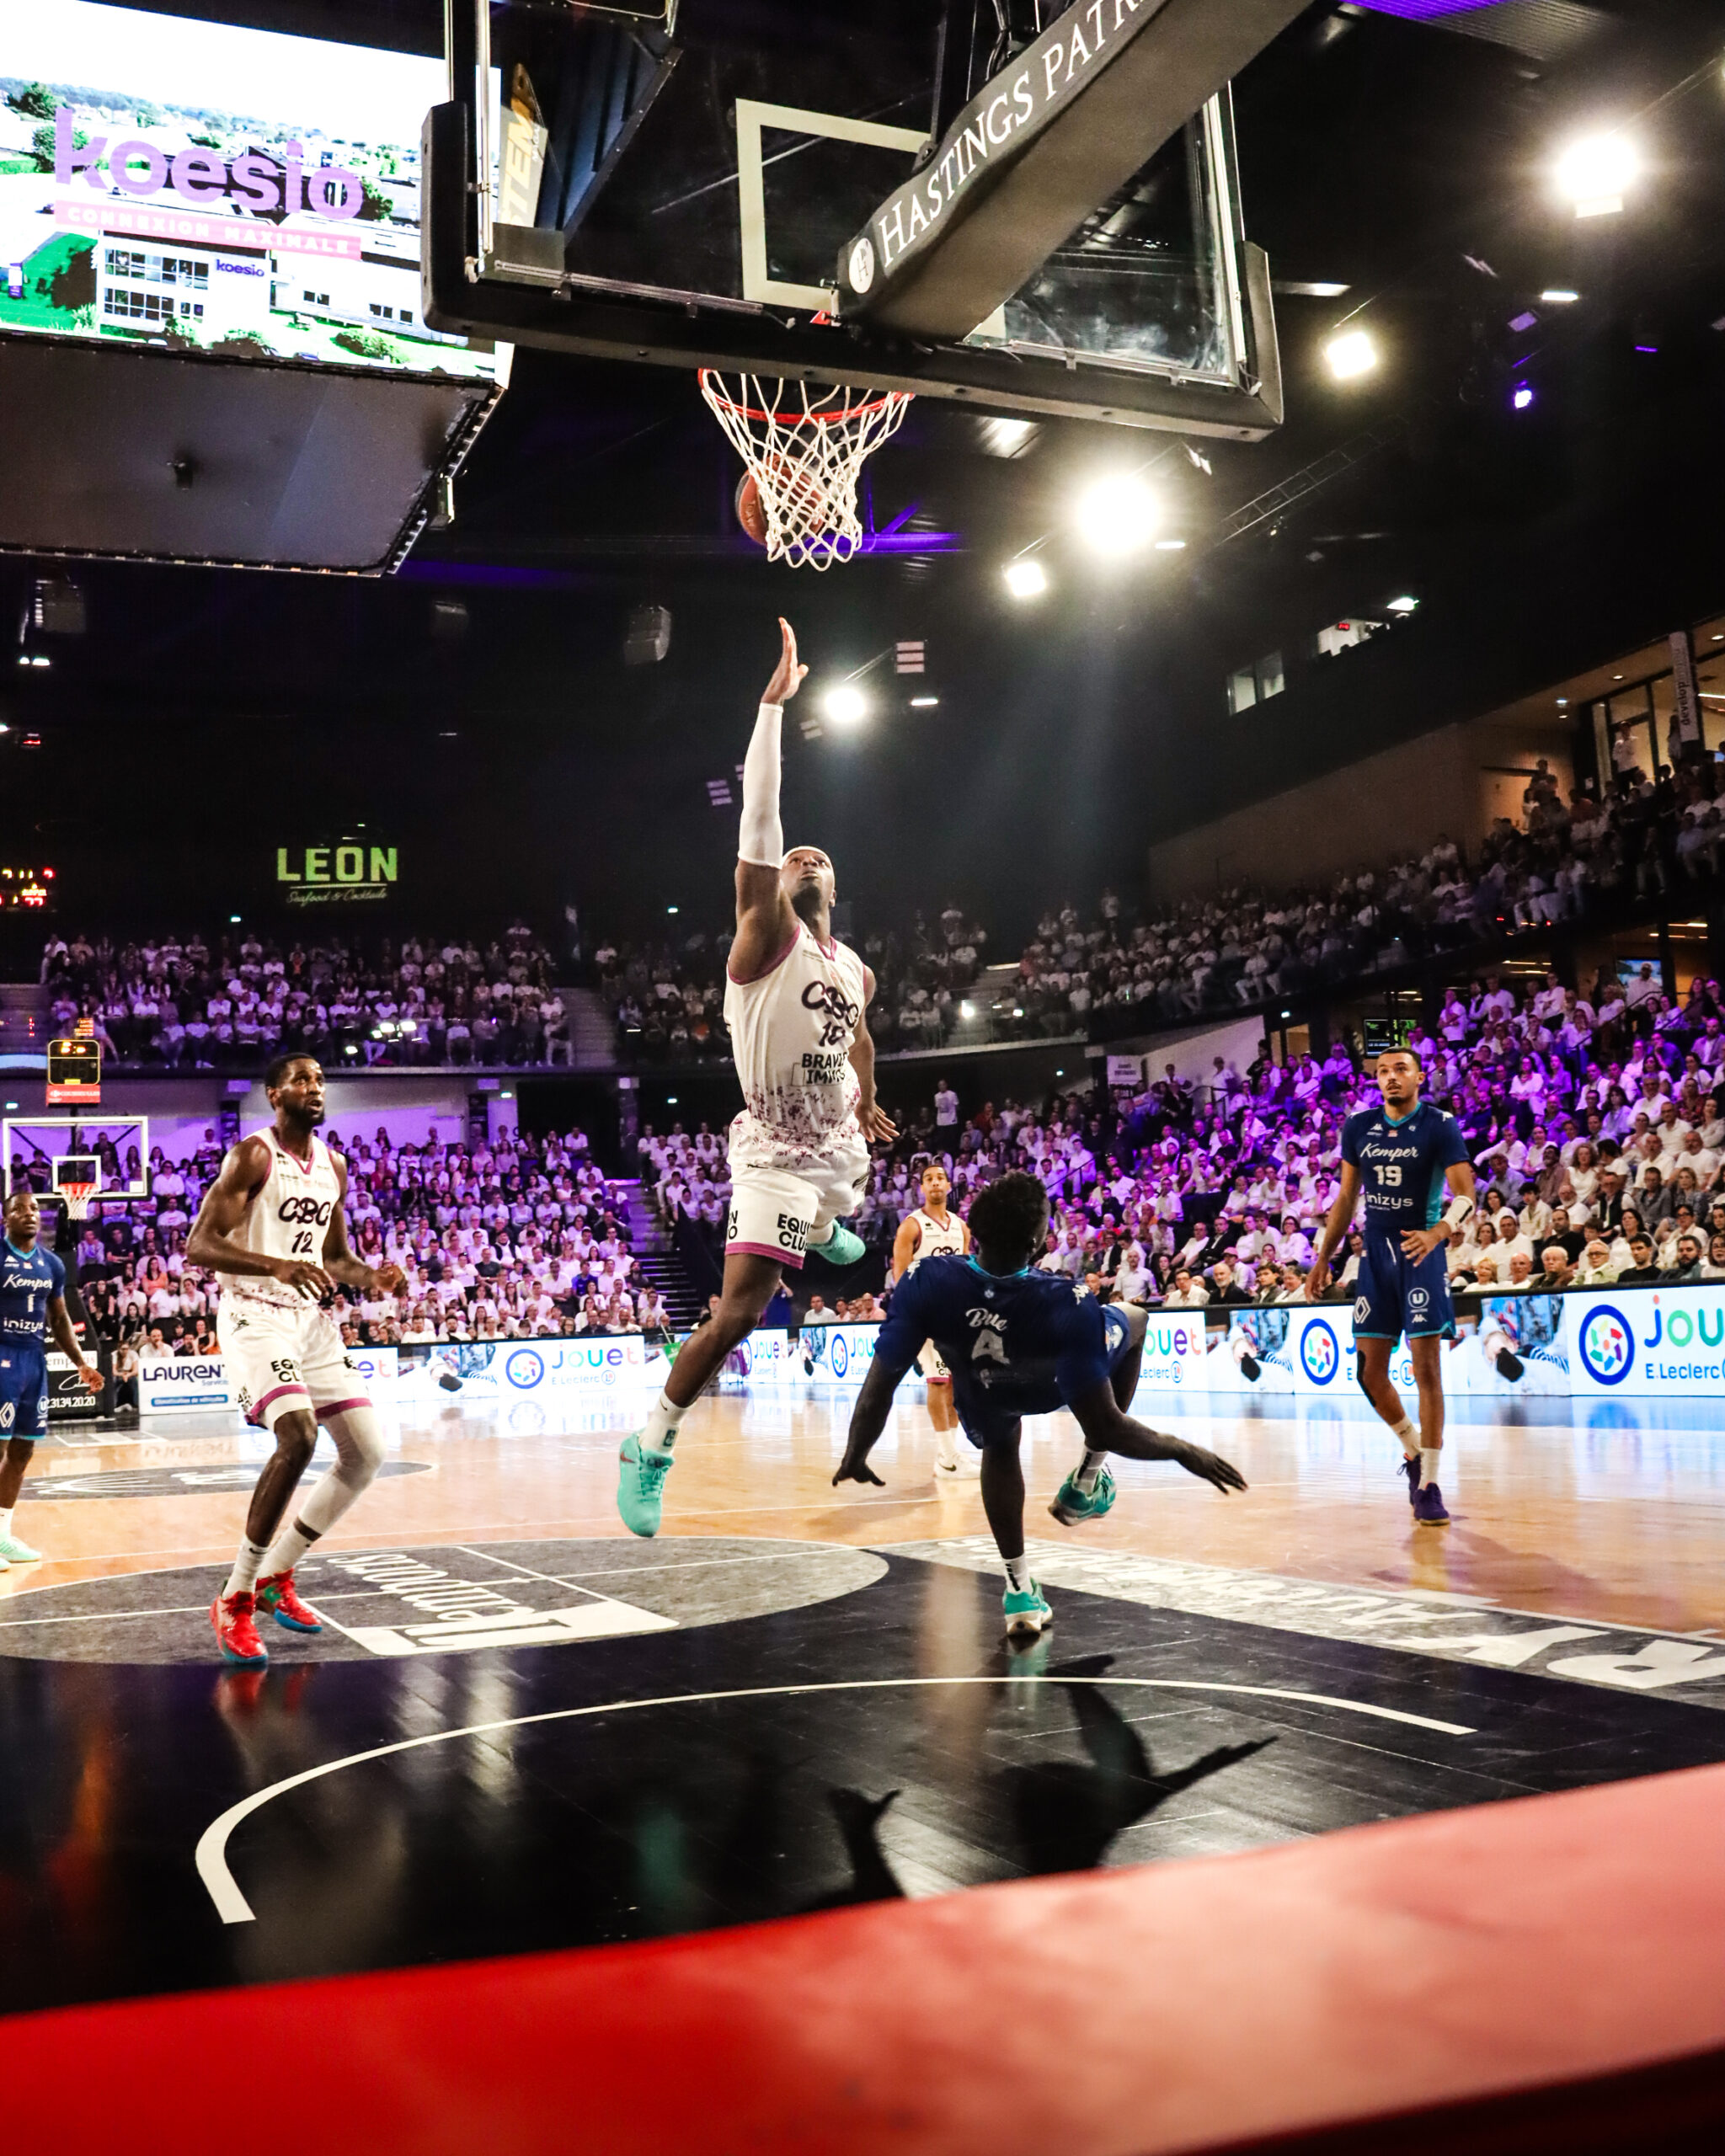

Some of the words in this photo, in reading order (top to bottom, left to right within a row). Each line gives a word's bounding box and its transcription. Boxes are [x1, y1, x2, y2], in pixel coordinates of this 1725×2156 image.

[55, 107, 365, 221] koesio
[879, 70, 1033, 268] HASTINGS
[67, 206, 211, 238] CONNEXION
[223, 223, 350, 255] MAXIMALE
[216, 259, 265, 277] koesio
[277, 846, 398, 881] LEON
[1360, 1143, 1419, 1161] Kemper
[1373, 1165, 1402, 1187] 19
[1365, 1191, 1413, 1209] inizys
[278, 1197, 331, 1226] CBC
[291, 1230, 313, 1253] 12
[3, 1274, 52, 1289] Kemper
[27, 1294, 35, 1312] 1
[3, 1318, 43, 1333] inizys
[551, 1343, 642, 1369] jouet
[142, 1364, 225, 1383] LAUREN
